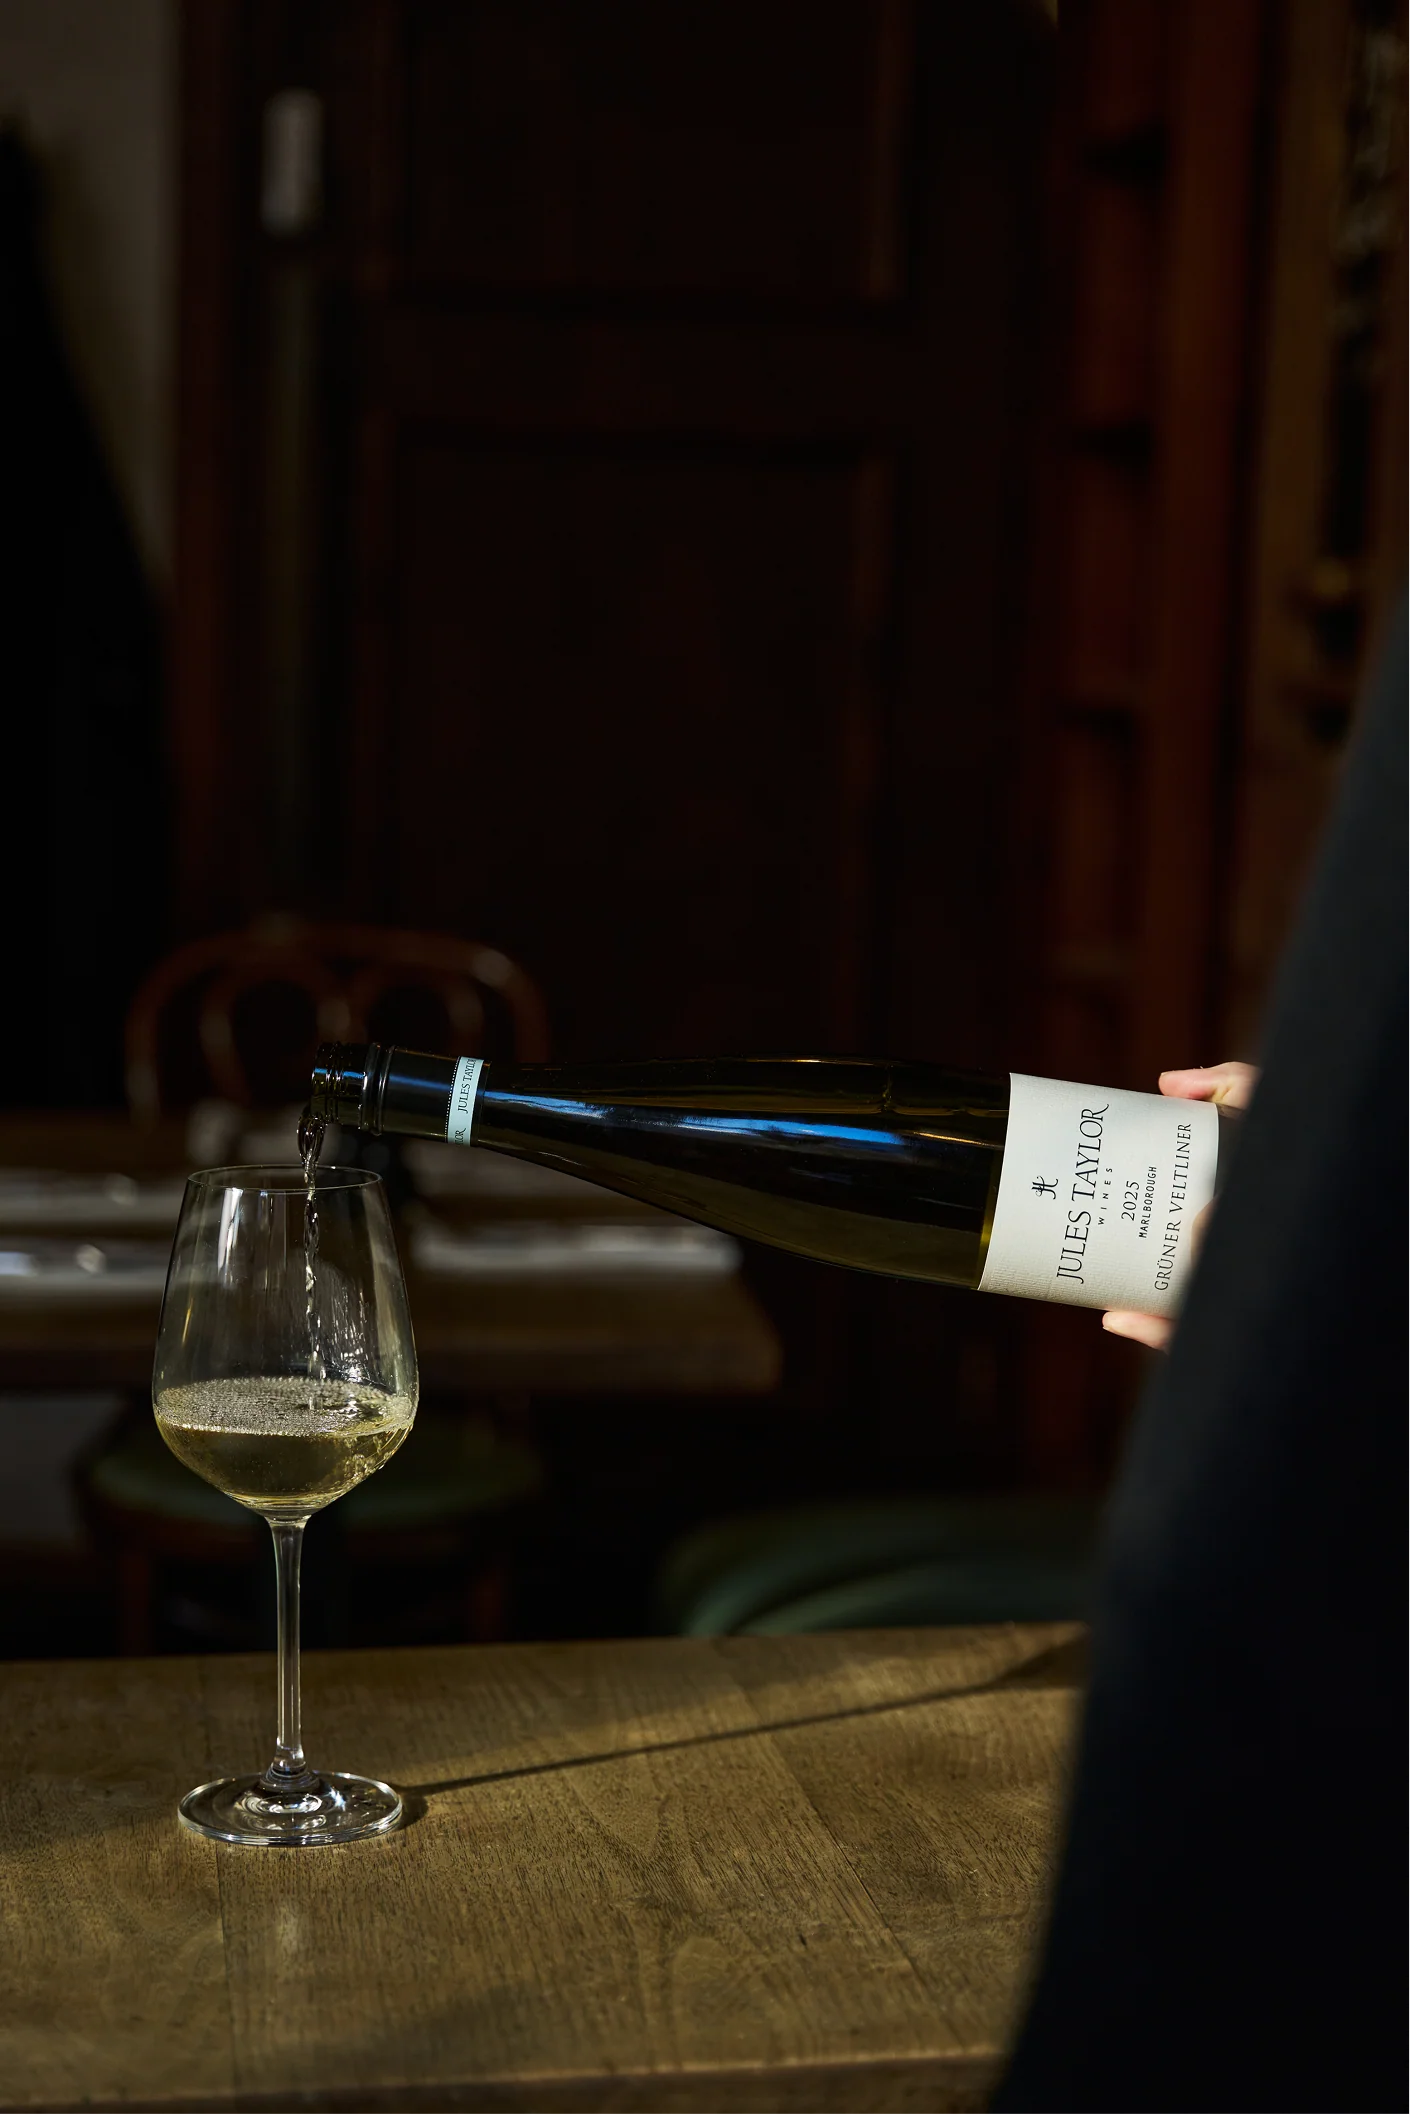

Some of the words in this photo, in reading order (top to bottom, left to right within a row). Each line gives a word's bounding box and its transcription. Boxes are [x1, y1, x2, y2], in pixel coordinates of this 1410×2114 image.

[457, 1083, 471, 1114] JULES
[1071, 1103, 1110, 1202] TAYLOR
[1098, 1167, 1113, 1226] WINES
[1121, 1180, 1140, 1222] 2025
[1138, 1166, 1158, 1239] MARLBOROUGH
[1154, 1220, 1182, 1291] GRÜNER
[1169, 1123, 1192, 1214] VELTLINER
[1056, 1210, 1092, 1285] JULES
